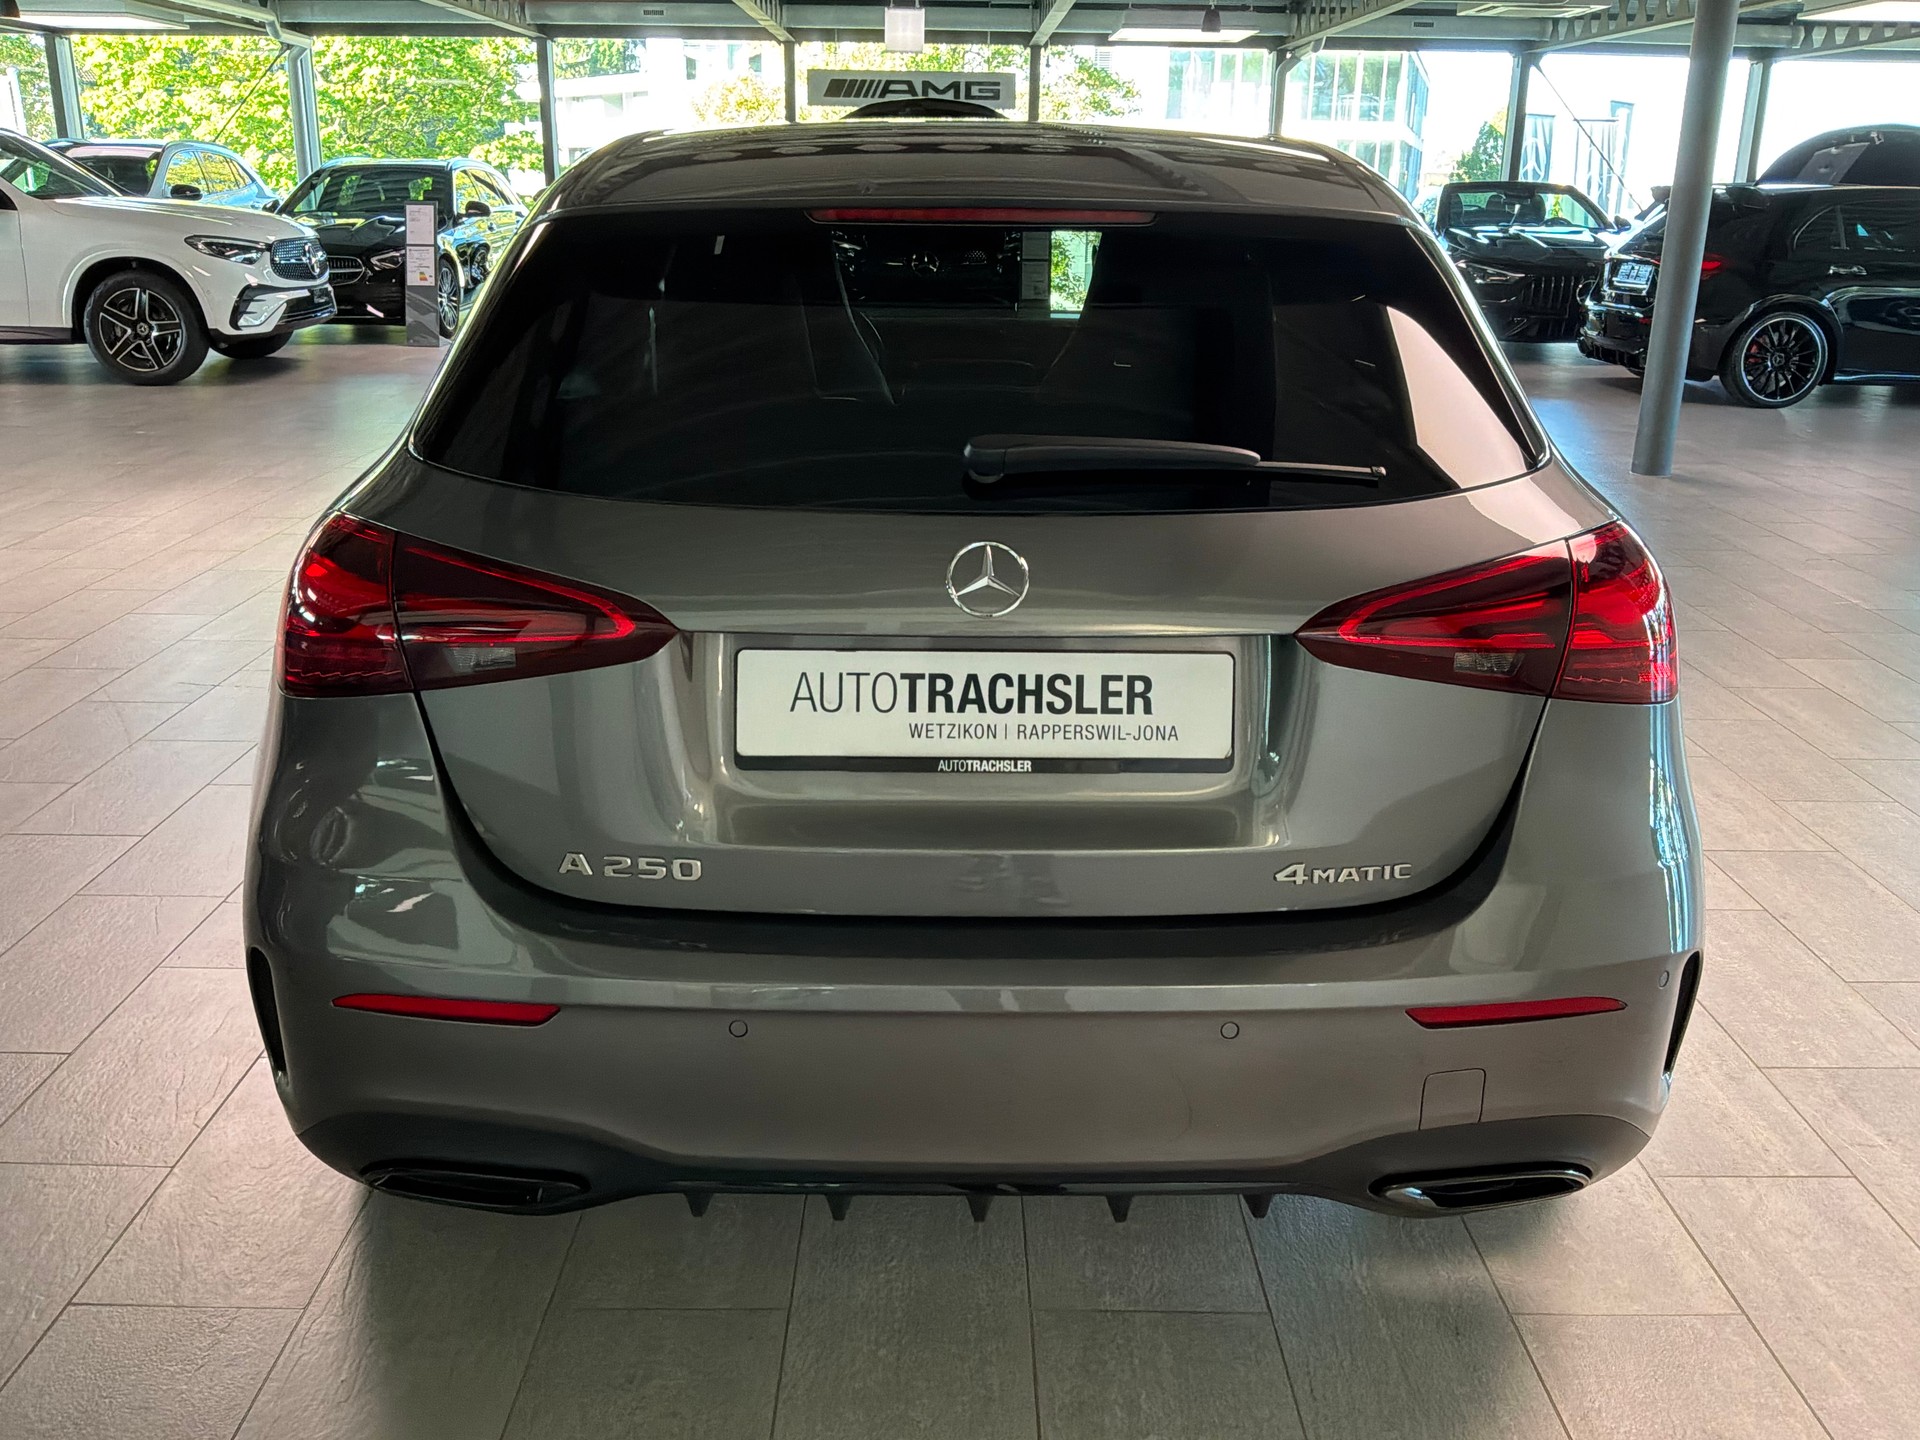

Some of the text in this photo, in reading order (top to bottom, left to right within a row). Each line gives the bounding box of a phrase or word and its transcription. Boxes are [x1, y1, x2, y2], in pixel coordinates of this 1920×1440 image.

[878, 79, 1001, 101] AMG
[790, 671, 1153, 715] AUTOTRACHSLER
[908, 722, 997, 740] WETZIKON
[1017, 723, 1179, 742] RAPPERSWIL-JONA
[937, 759, 1032, 773] AUTOTRACHSLER
[558, 852, 702, 881] A 250
[1274, 862, 1413, 885] 4MATIC
